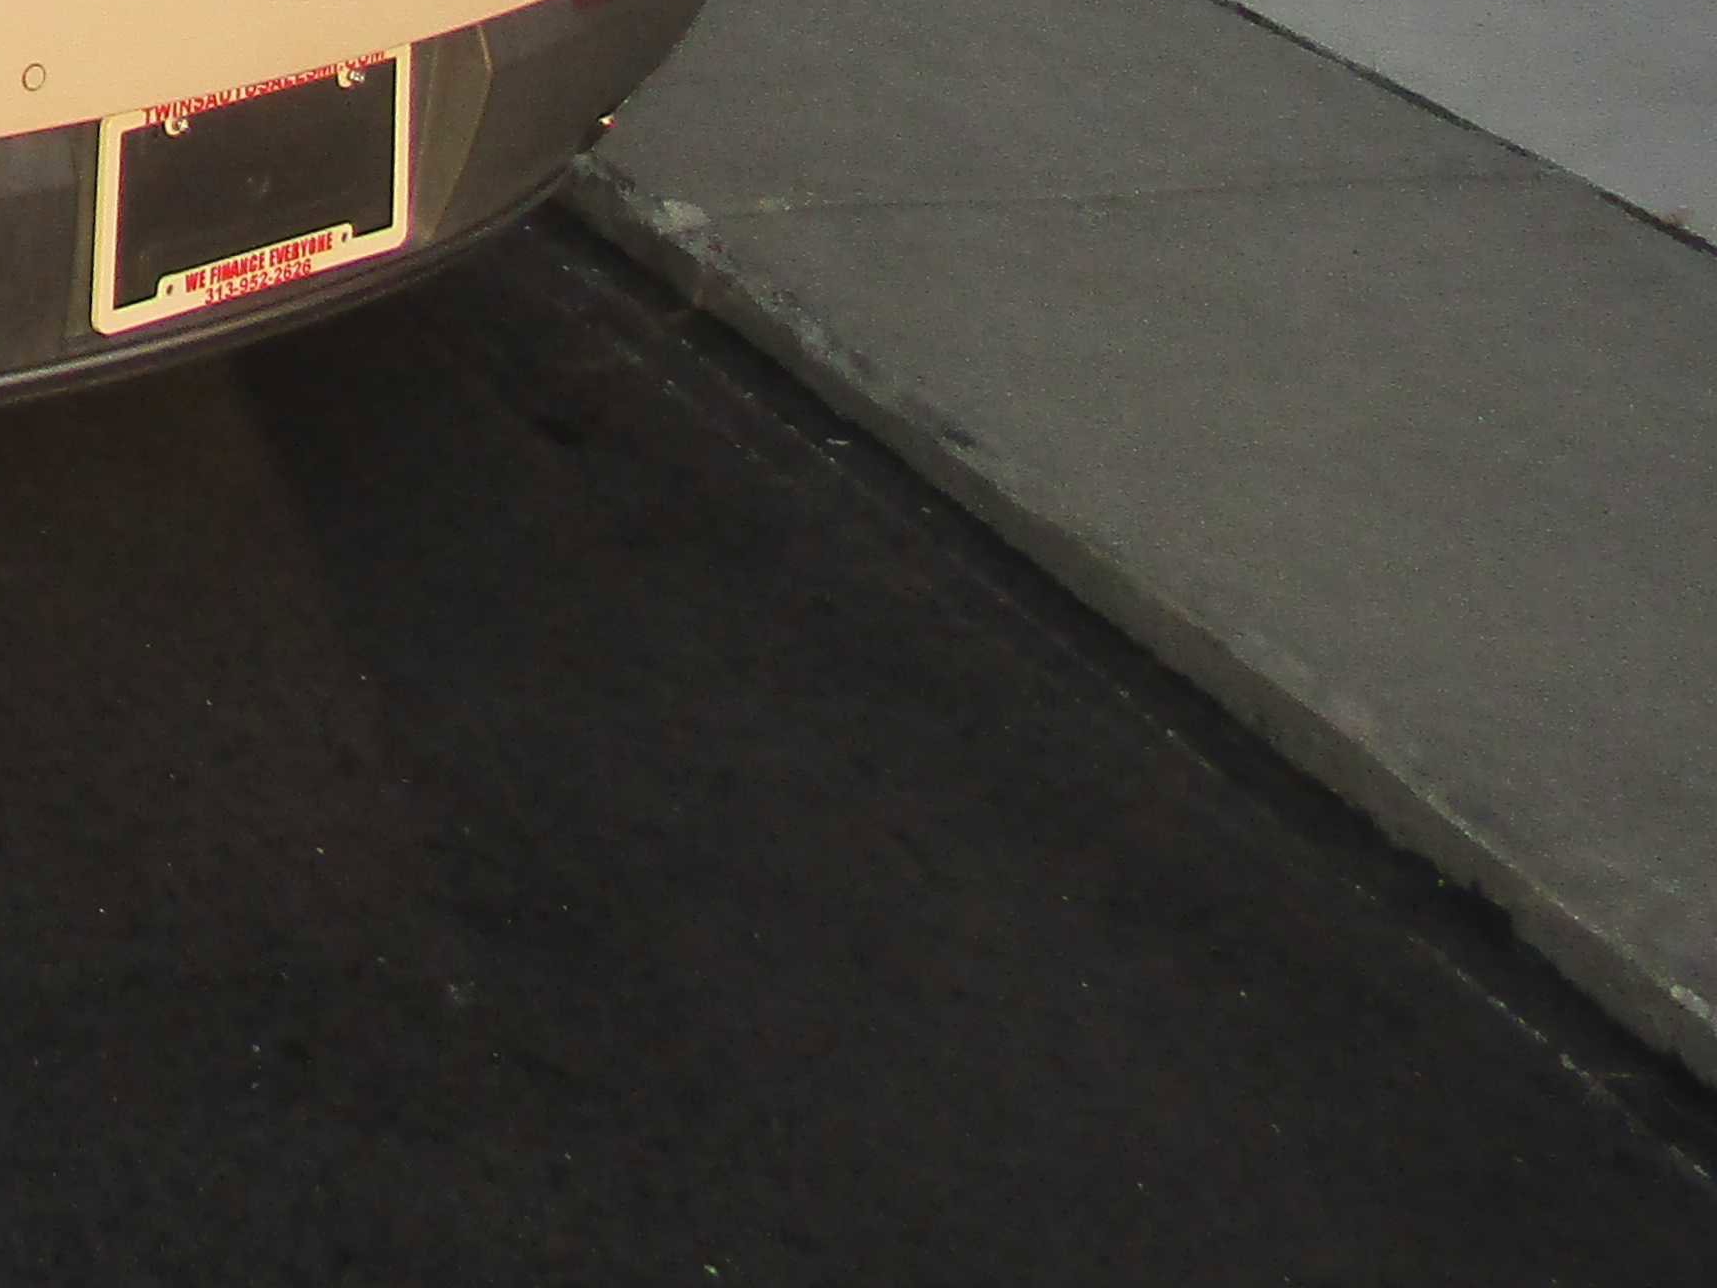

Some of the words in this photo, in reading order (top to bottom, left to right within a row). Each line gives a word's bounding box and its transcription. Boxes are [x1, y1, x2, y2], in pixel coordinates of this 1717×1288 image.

[185, 270, 206, 293] WE
[210, 251, 266, 285] FINANCE
[269, 231, 333, 267] EVERYONE
[205, 259, 312, 305] 313-952-2626
